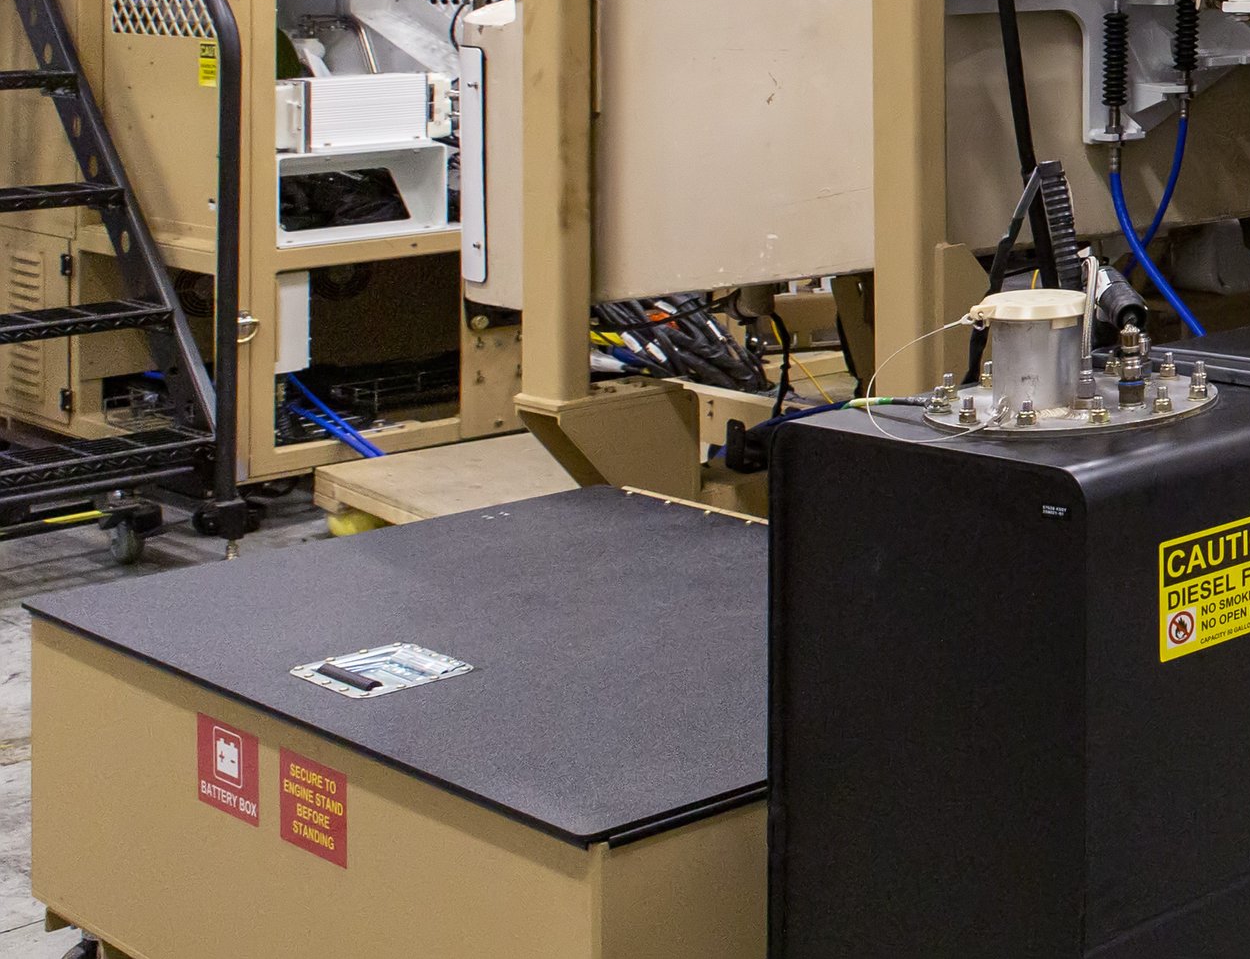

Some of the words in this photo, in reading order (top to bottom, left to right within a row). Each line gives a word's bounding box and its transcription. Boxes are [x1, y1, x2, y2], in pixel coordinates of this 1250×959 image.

[1168, 573, 1236, 611] DIESEL
[1201, 602, 1217, 616] NO
[1201, 617, 1217, 632] NO
[1219, 606, 1247, 625] OPEN
[1200, 630, 1227, 644] CAPACITY
[289, 763, 323, 789] SECURE
[324, 777, 337, 795] TO
[200, 779, 238, 808] BATTERY
[239, 797, 257, 818] BOX
[283, 778, 314, 804] ENGINE
[315, 792, 344, 816] STAND
[296, 802, 330, 829] BEFORE
[292, 819, 335, 850] STANDING
